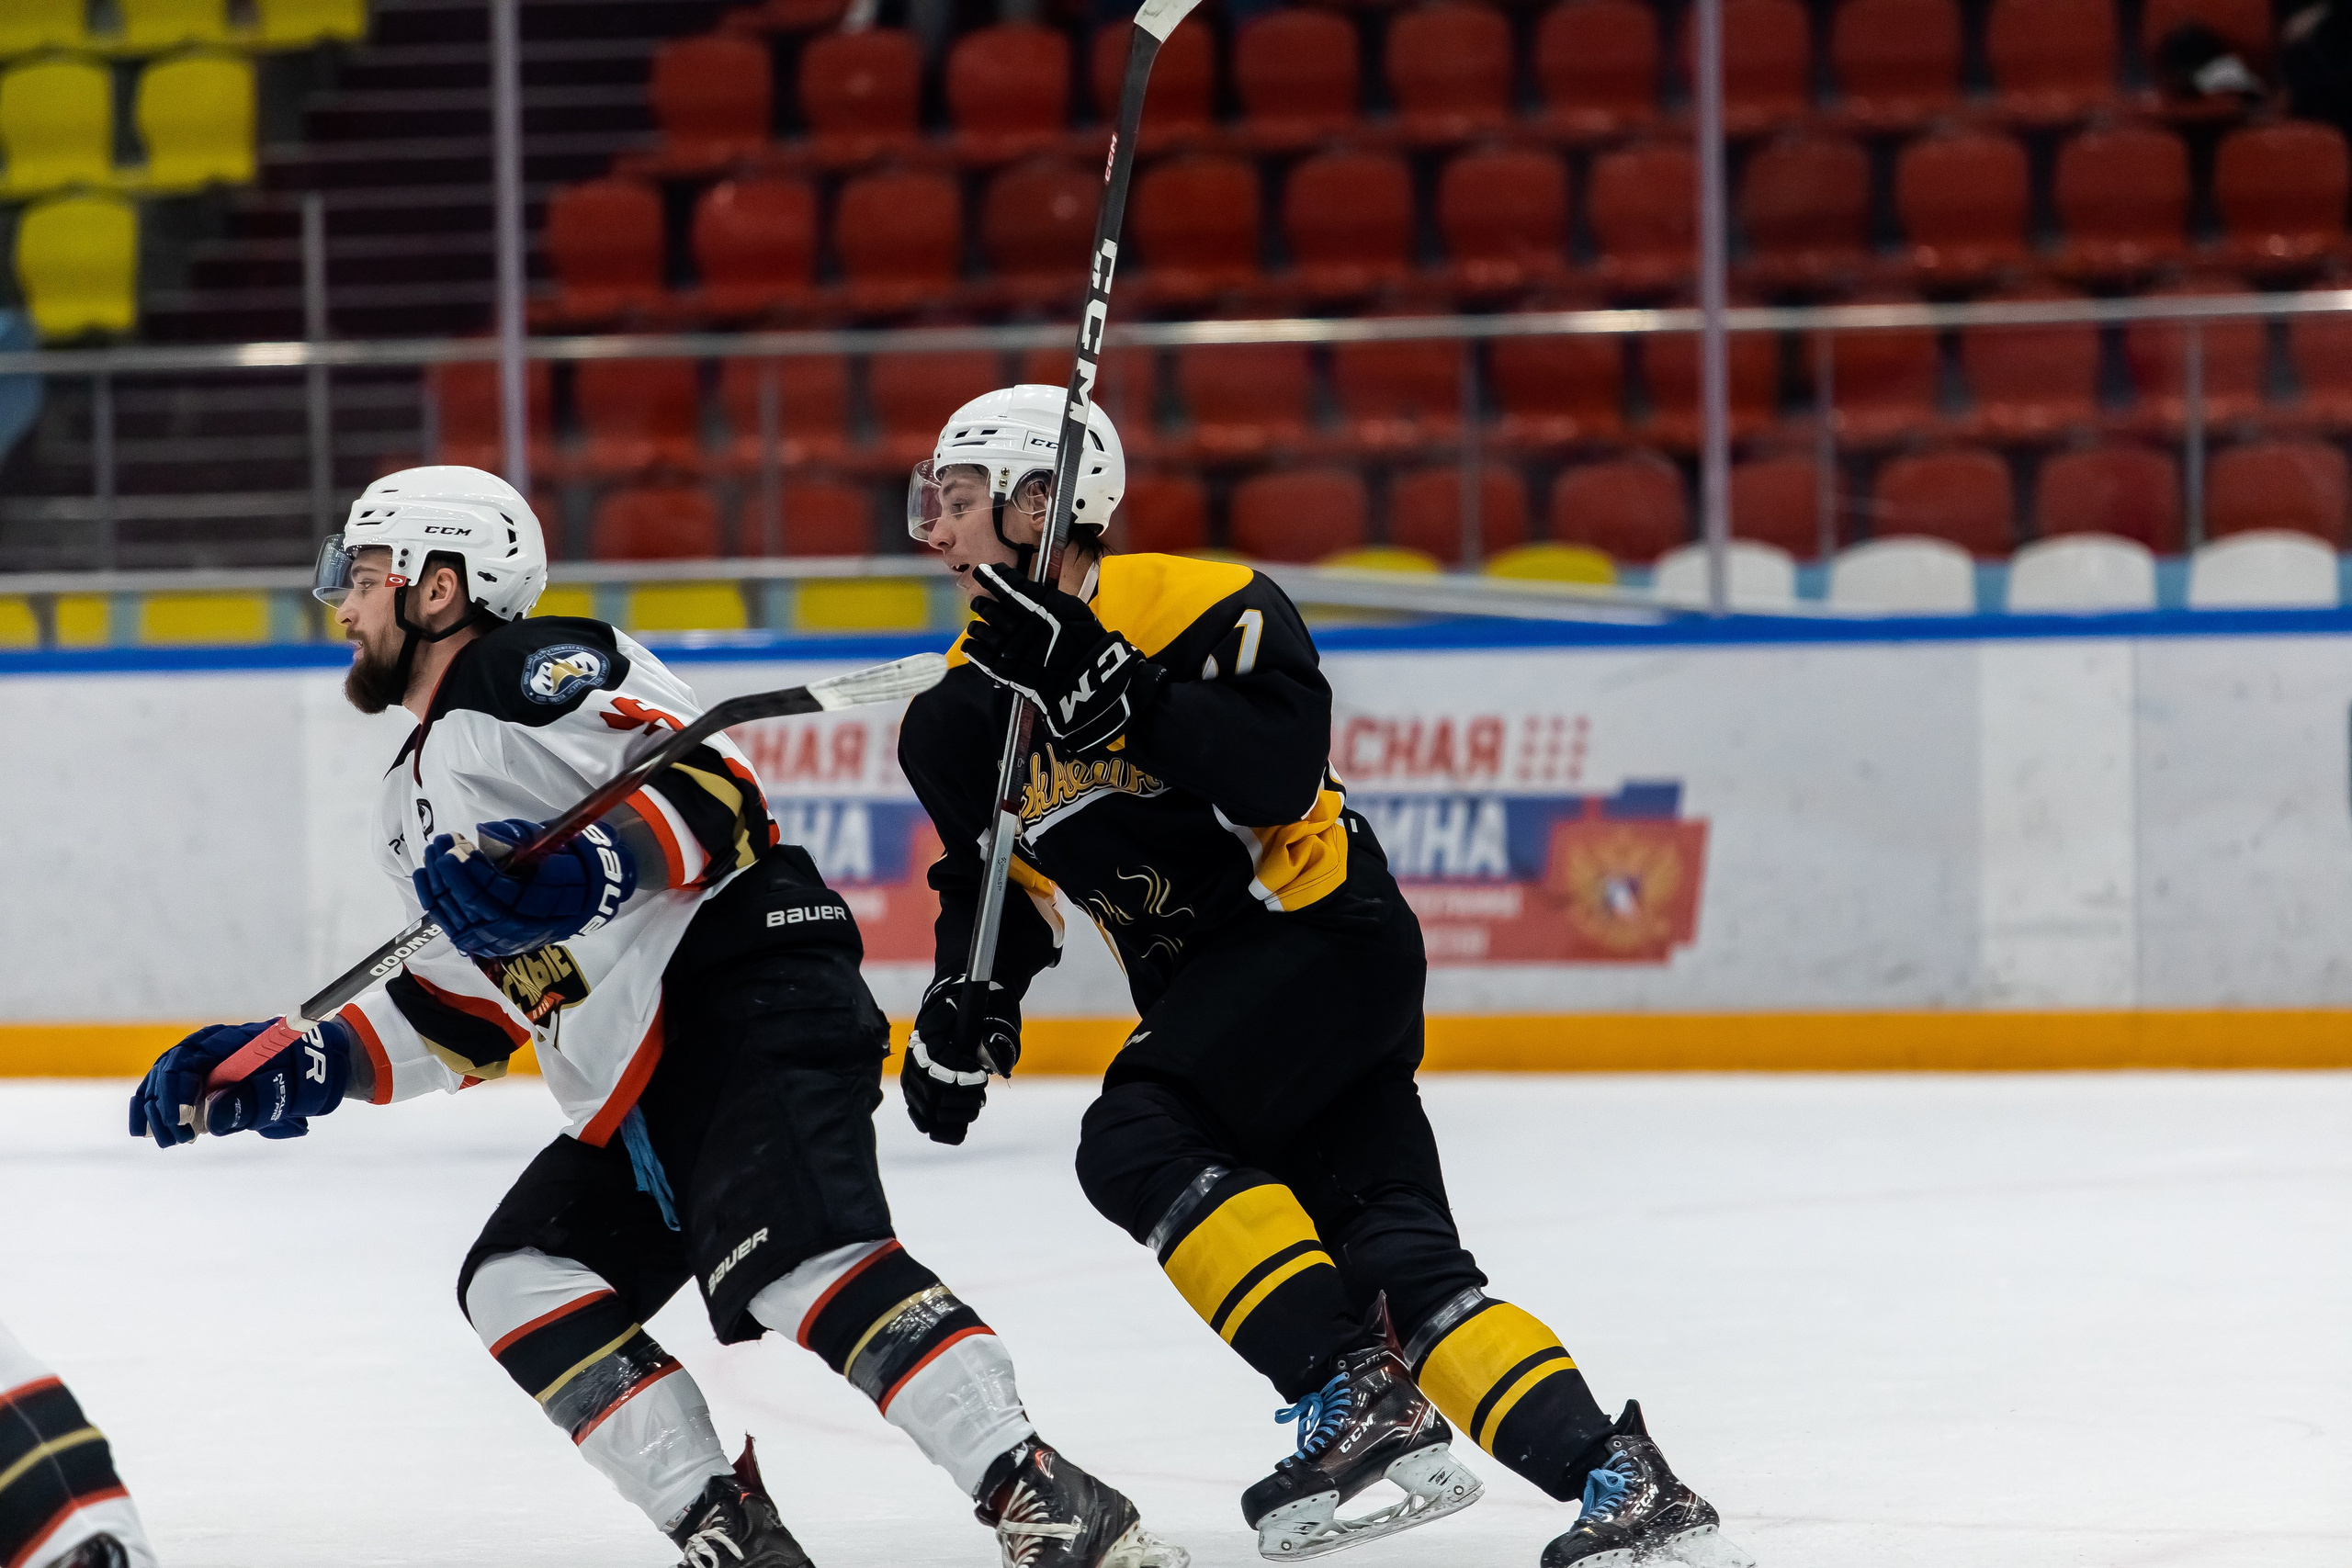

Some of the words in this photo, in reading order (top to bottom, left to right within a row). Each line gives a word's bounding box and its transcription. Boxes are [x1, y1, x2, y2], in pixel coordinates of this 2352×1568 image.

[1104, 132, 1118, 184] CCM
[1069, 238, 1118, 425] CCM
[1030, 437, 1058, 450] CC
[424, 525, 471, 536] CCM
[1058, 641, 1137, 724] CM
[369, 923, 443, 976] R-WOOD
[1339, 1413, 1374, 1454] CCM
[1631, 1483, 1660, 1516] CCM
